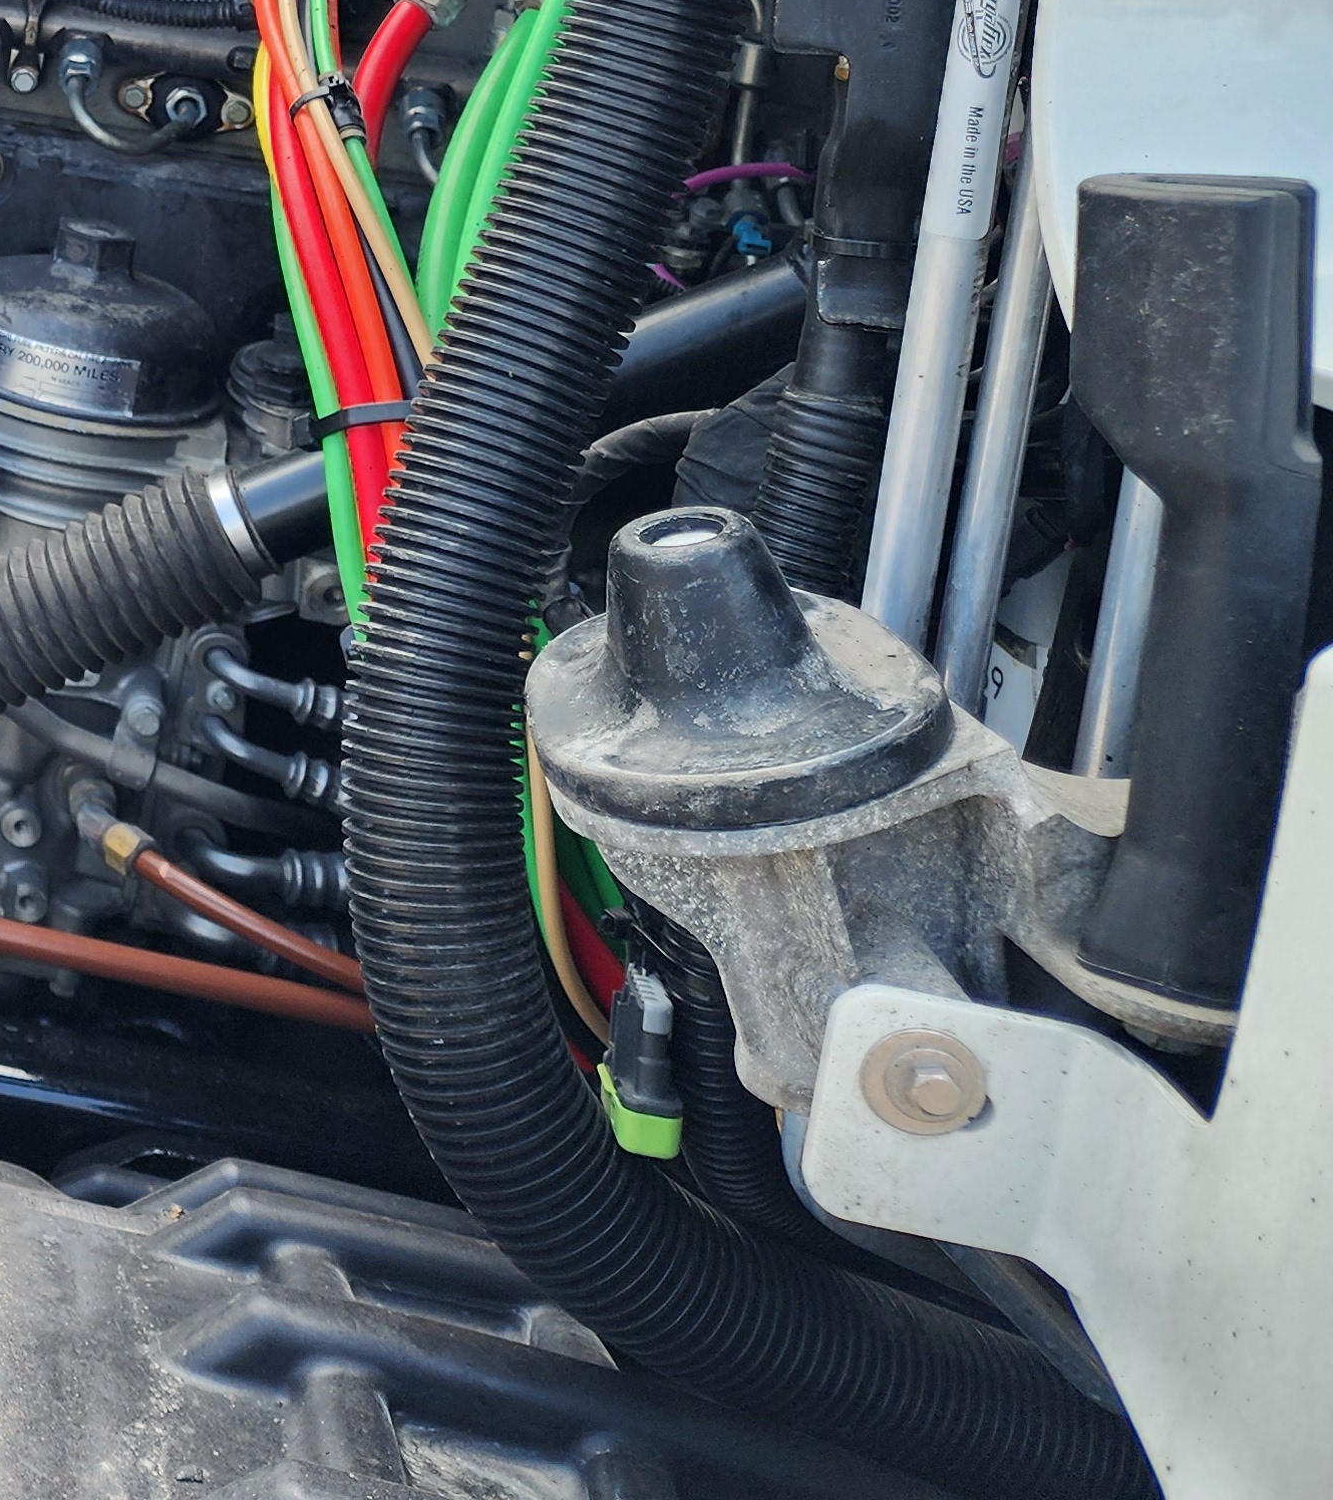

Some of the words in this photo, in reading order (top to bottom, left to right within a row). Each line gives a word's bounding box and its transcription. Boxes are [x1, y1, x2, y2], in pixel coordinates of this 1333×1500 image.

[967, 105, 984, 142] Made
[964, 147, 978, 160] in
[961, 164, 976, 185] the
[956, 188, 974, 216] USA
[17, 351, 70, 374] 200,000
